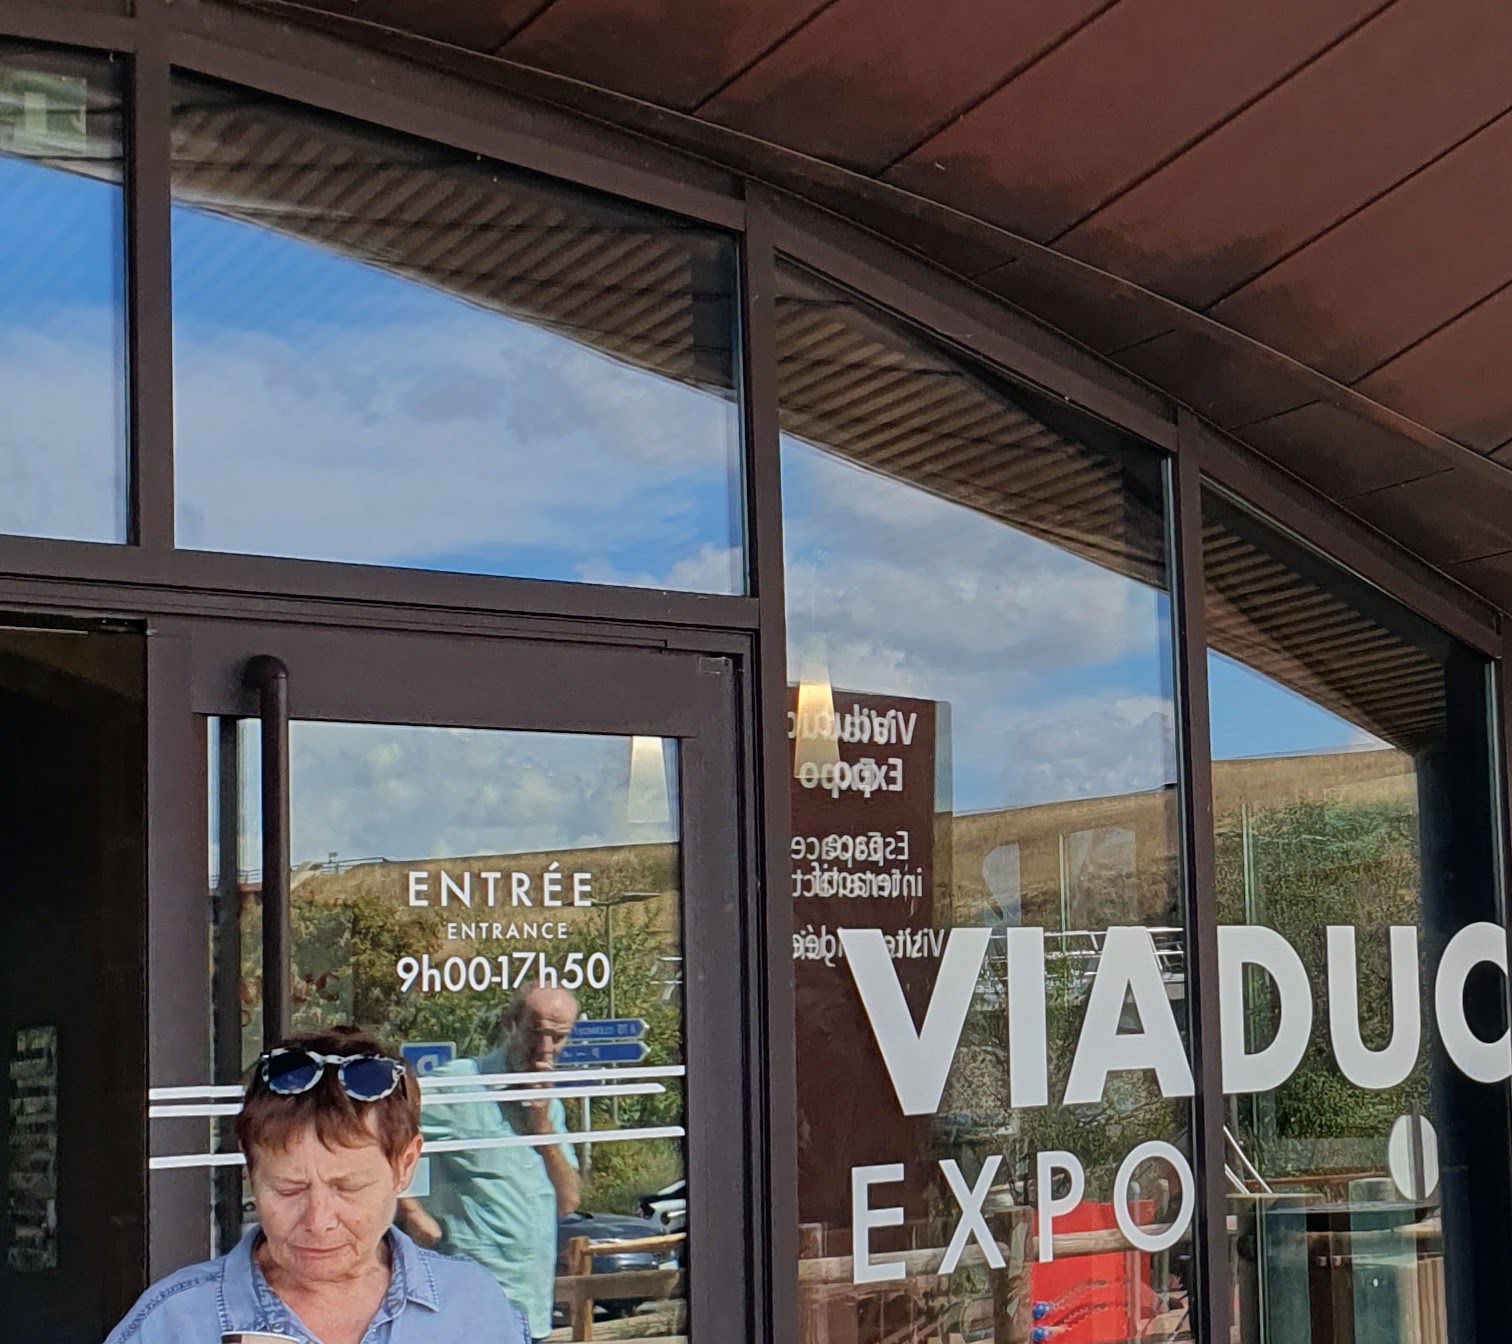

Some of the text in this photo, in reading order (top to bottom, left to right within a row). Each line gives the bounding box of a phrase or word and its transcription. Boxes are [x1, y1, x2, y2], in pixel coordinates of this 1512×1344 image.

[408, 861, 592, 907] ENTRÉE
[447, 922, 568, 939] ENTRANCE
[396, 951, 611, 992] 9h00-17h50
[837, 921, 1512, 1116] VIADUC
[851, 1140, 1195, 1284] EXPO
